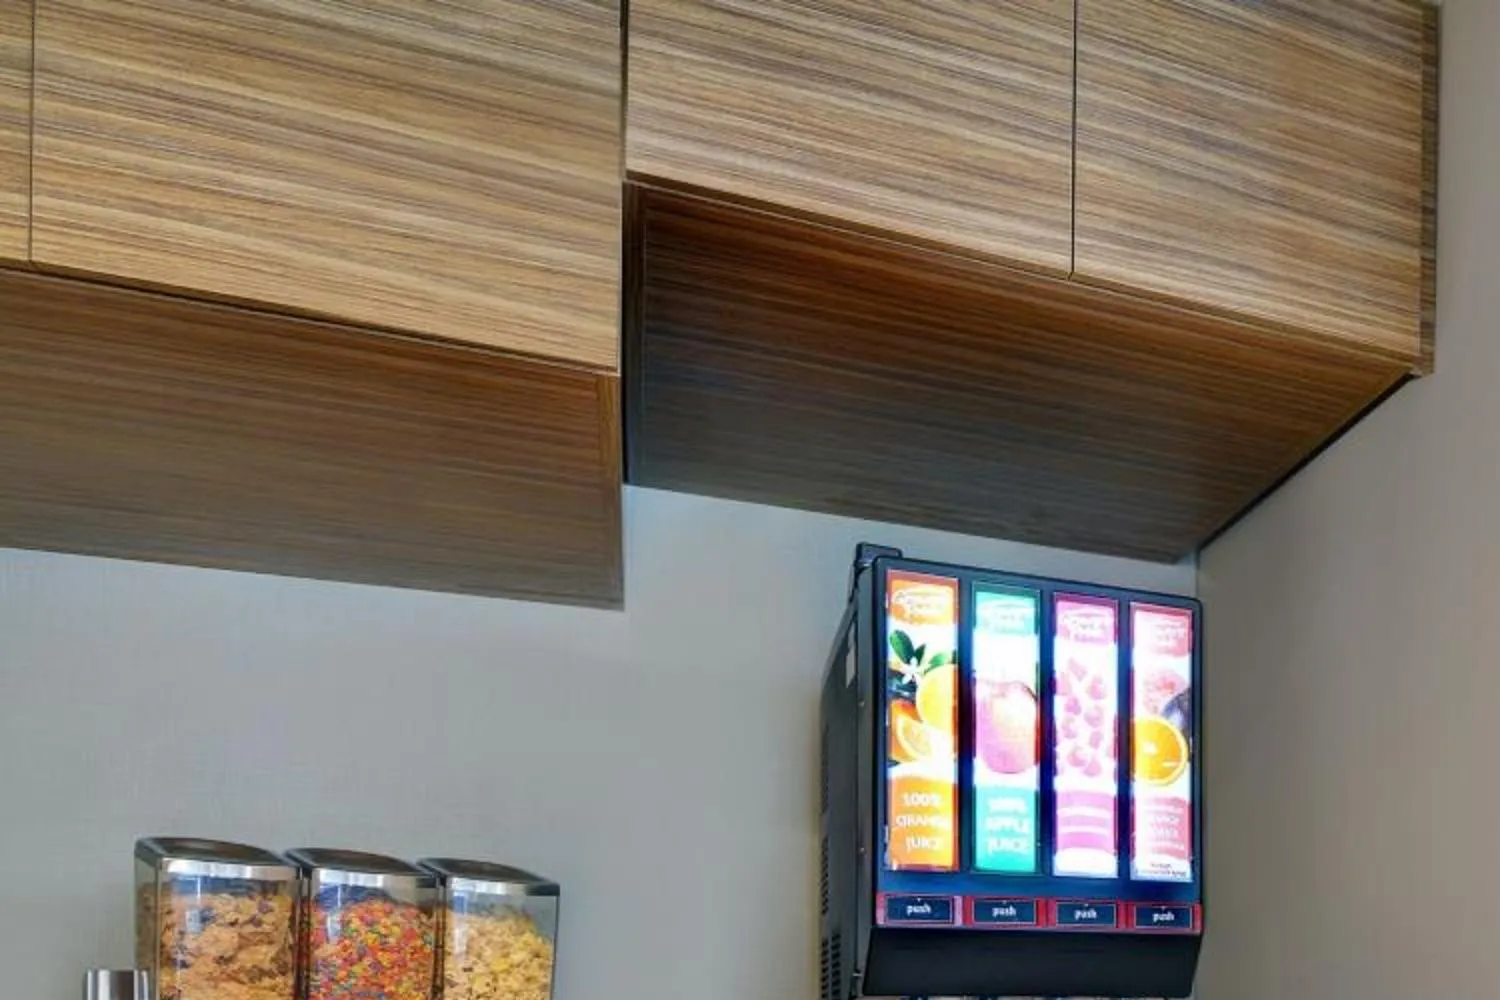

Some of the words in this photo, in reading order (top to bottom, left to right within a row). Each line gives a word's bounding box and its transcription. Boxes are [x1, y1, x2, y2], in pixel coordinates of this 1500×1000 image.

[905, 835, 943, 853] JUICE
[906, 902, 932, 917] push
[991, 904, 1017, 918] push
[1074, 908, 1098, 921] push
[1152, 911, 1176, 923] push
